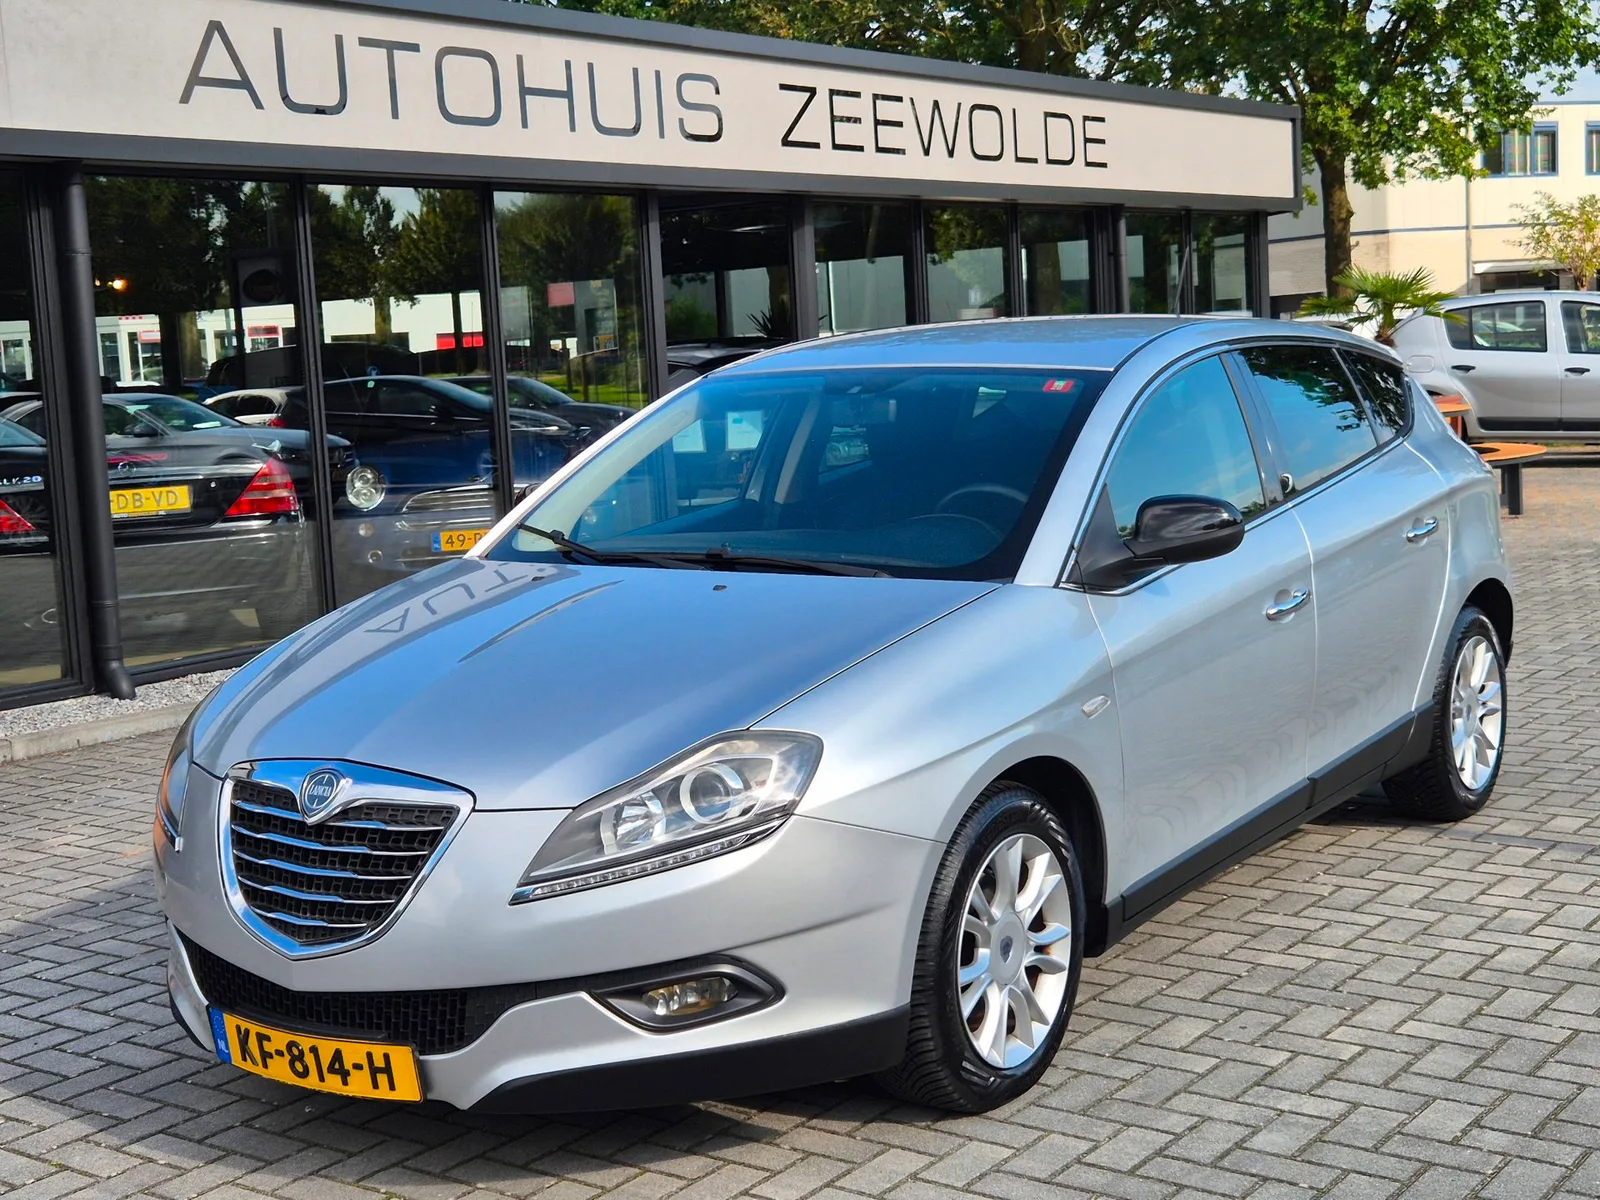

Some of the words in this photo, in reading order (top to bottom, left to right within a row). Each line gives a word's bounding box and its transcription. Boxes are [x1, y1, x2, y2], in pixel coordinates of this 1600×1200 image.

[179, 20, 724, 143] AUTOHUIS
[779, 84, 1108, 169] ZEEWOLDE
[235, 1024, 396, 1092] KF-814-H
